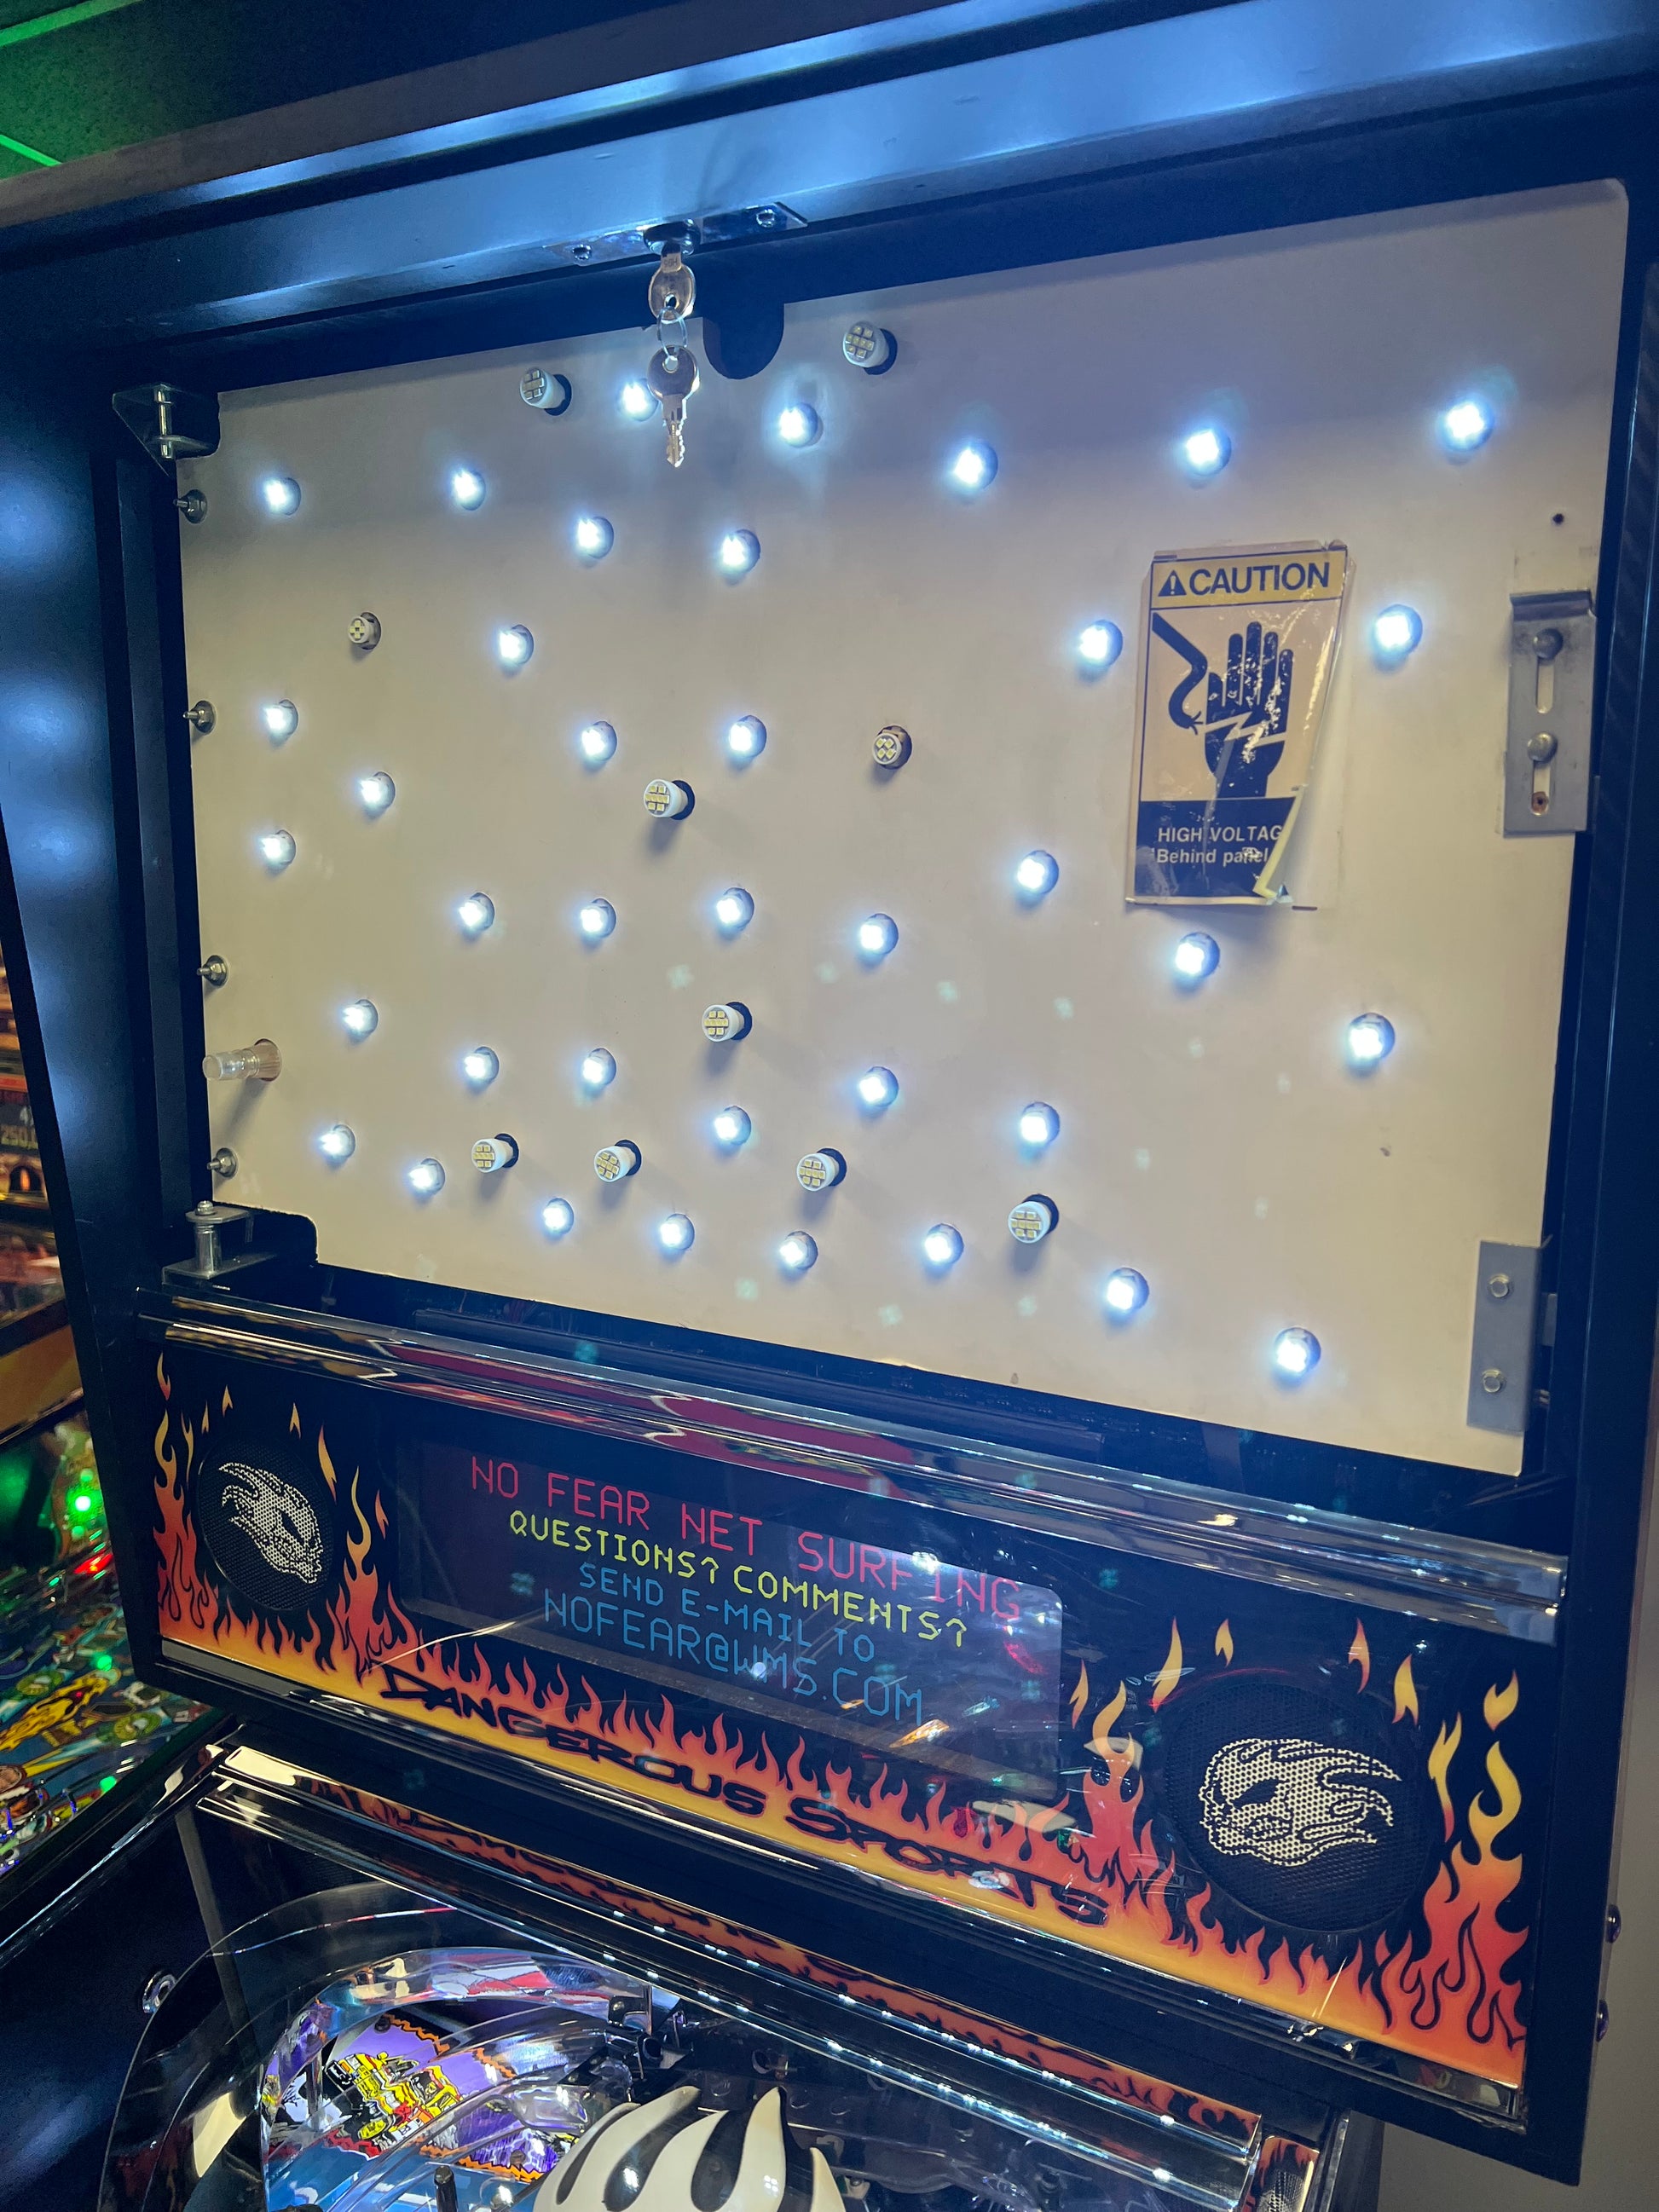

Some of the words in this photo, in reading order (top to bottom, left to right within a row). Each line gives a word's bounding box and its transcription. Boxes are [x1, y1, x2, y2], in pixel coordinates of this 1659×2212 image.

[1189, 562, 1330, 596] CAUTION
[1156, 848, 1217, 863] Behind
[1158, 826, 1203, 843] HIGH
[1210, 825, 1283, 842] VOLTAG
[472, 1455, 518, 1499] NO
[547, 1472, 650, 1531] FEAR
[681, 1502, 763, 1556] NET
[798, 1531, 1020, 1620] SURFING
[510, 1510, 719, 1584] QUESTIONS?
[733, 1565, 967, 1647] COMMENTS?
[545, 1587, 922, 1726] NOFEAR@WMS.COM
[579, 1562, 664, 1607] SEND
[682, 1588, 812, 1648] E-MAIL
[834, 1627, 875, 1662] TO
[379, 1663, 767, 1816] DANGEROUS
[784, 1796, 1109, 1927] SPORTS
